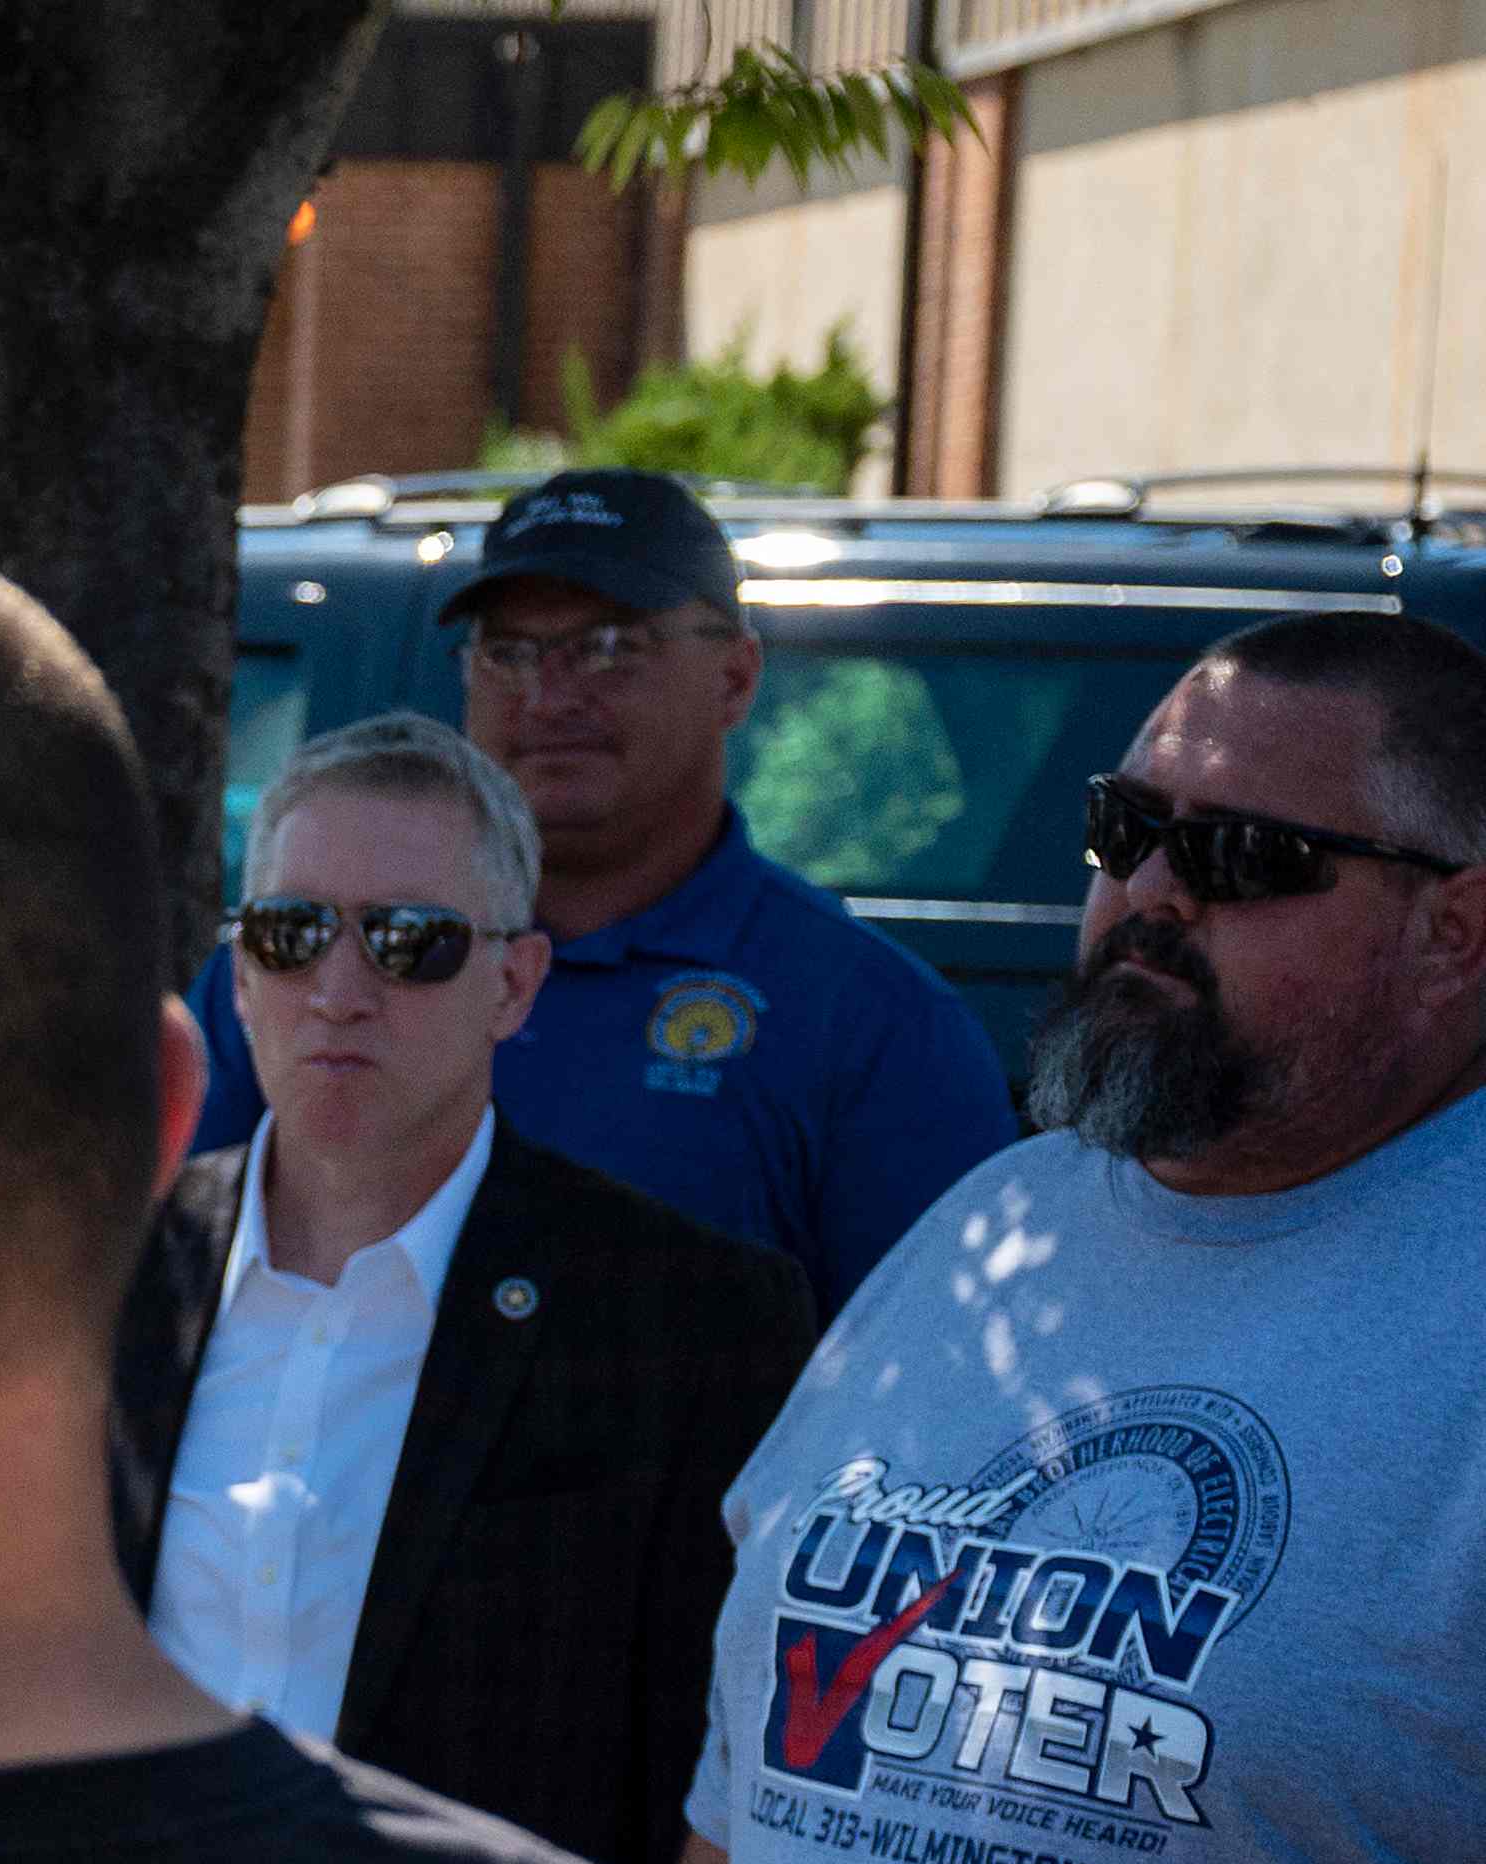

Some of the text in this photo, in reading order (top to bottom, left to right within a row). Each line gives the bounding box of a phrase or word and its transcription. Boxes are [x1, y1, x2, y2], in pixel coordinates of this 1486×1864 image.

[793, 1456, 1038, 1534] Proud
[784, 1512, 1240, 1690] UNION
[750, 1780, 807, 1838] LOCAL
[871, 1773, 1168, 1856] MAKE YOUR VOICE HEARD!
